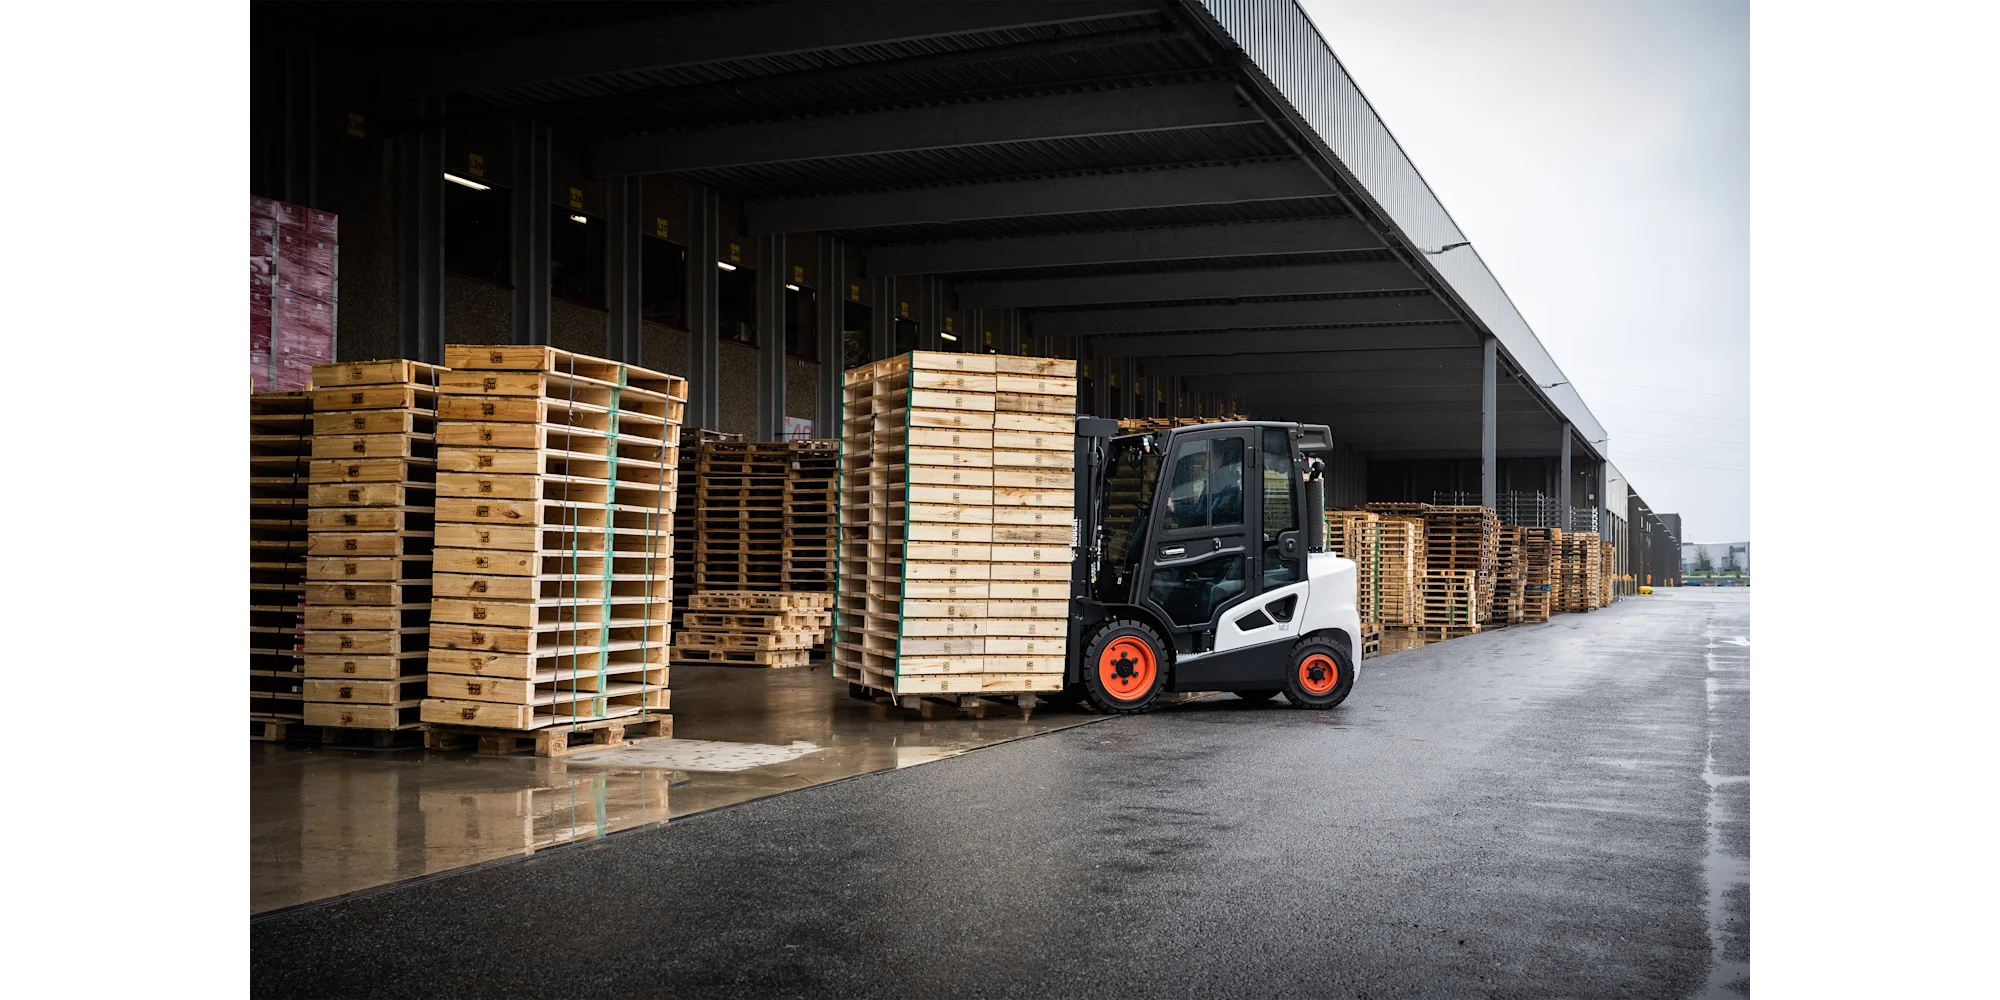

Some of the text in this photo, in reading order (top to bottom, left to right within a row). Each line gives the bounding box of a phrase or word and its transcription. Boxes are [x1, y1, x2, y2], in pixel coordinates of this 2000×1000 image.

[348, 118, 364, 131] L30
[470, 159, 483, 170] L29
[570, 193, 582, 203] L28
[658, 222, 667, 232] L27
